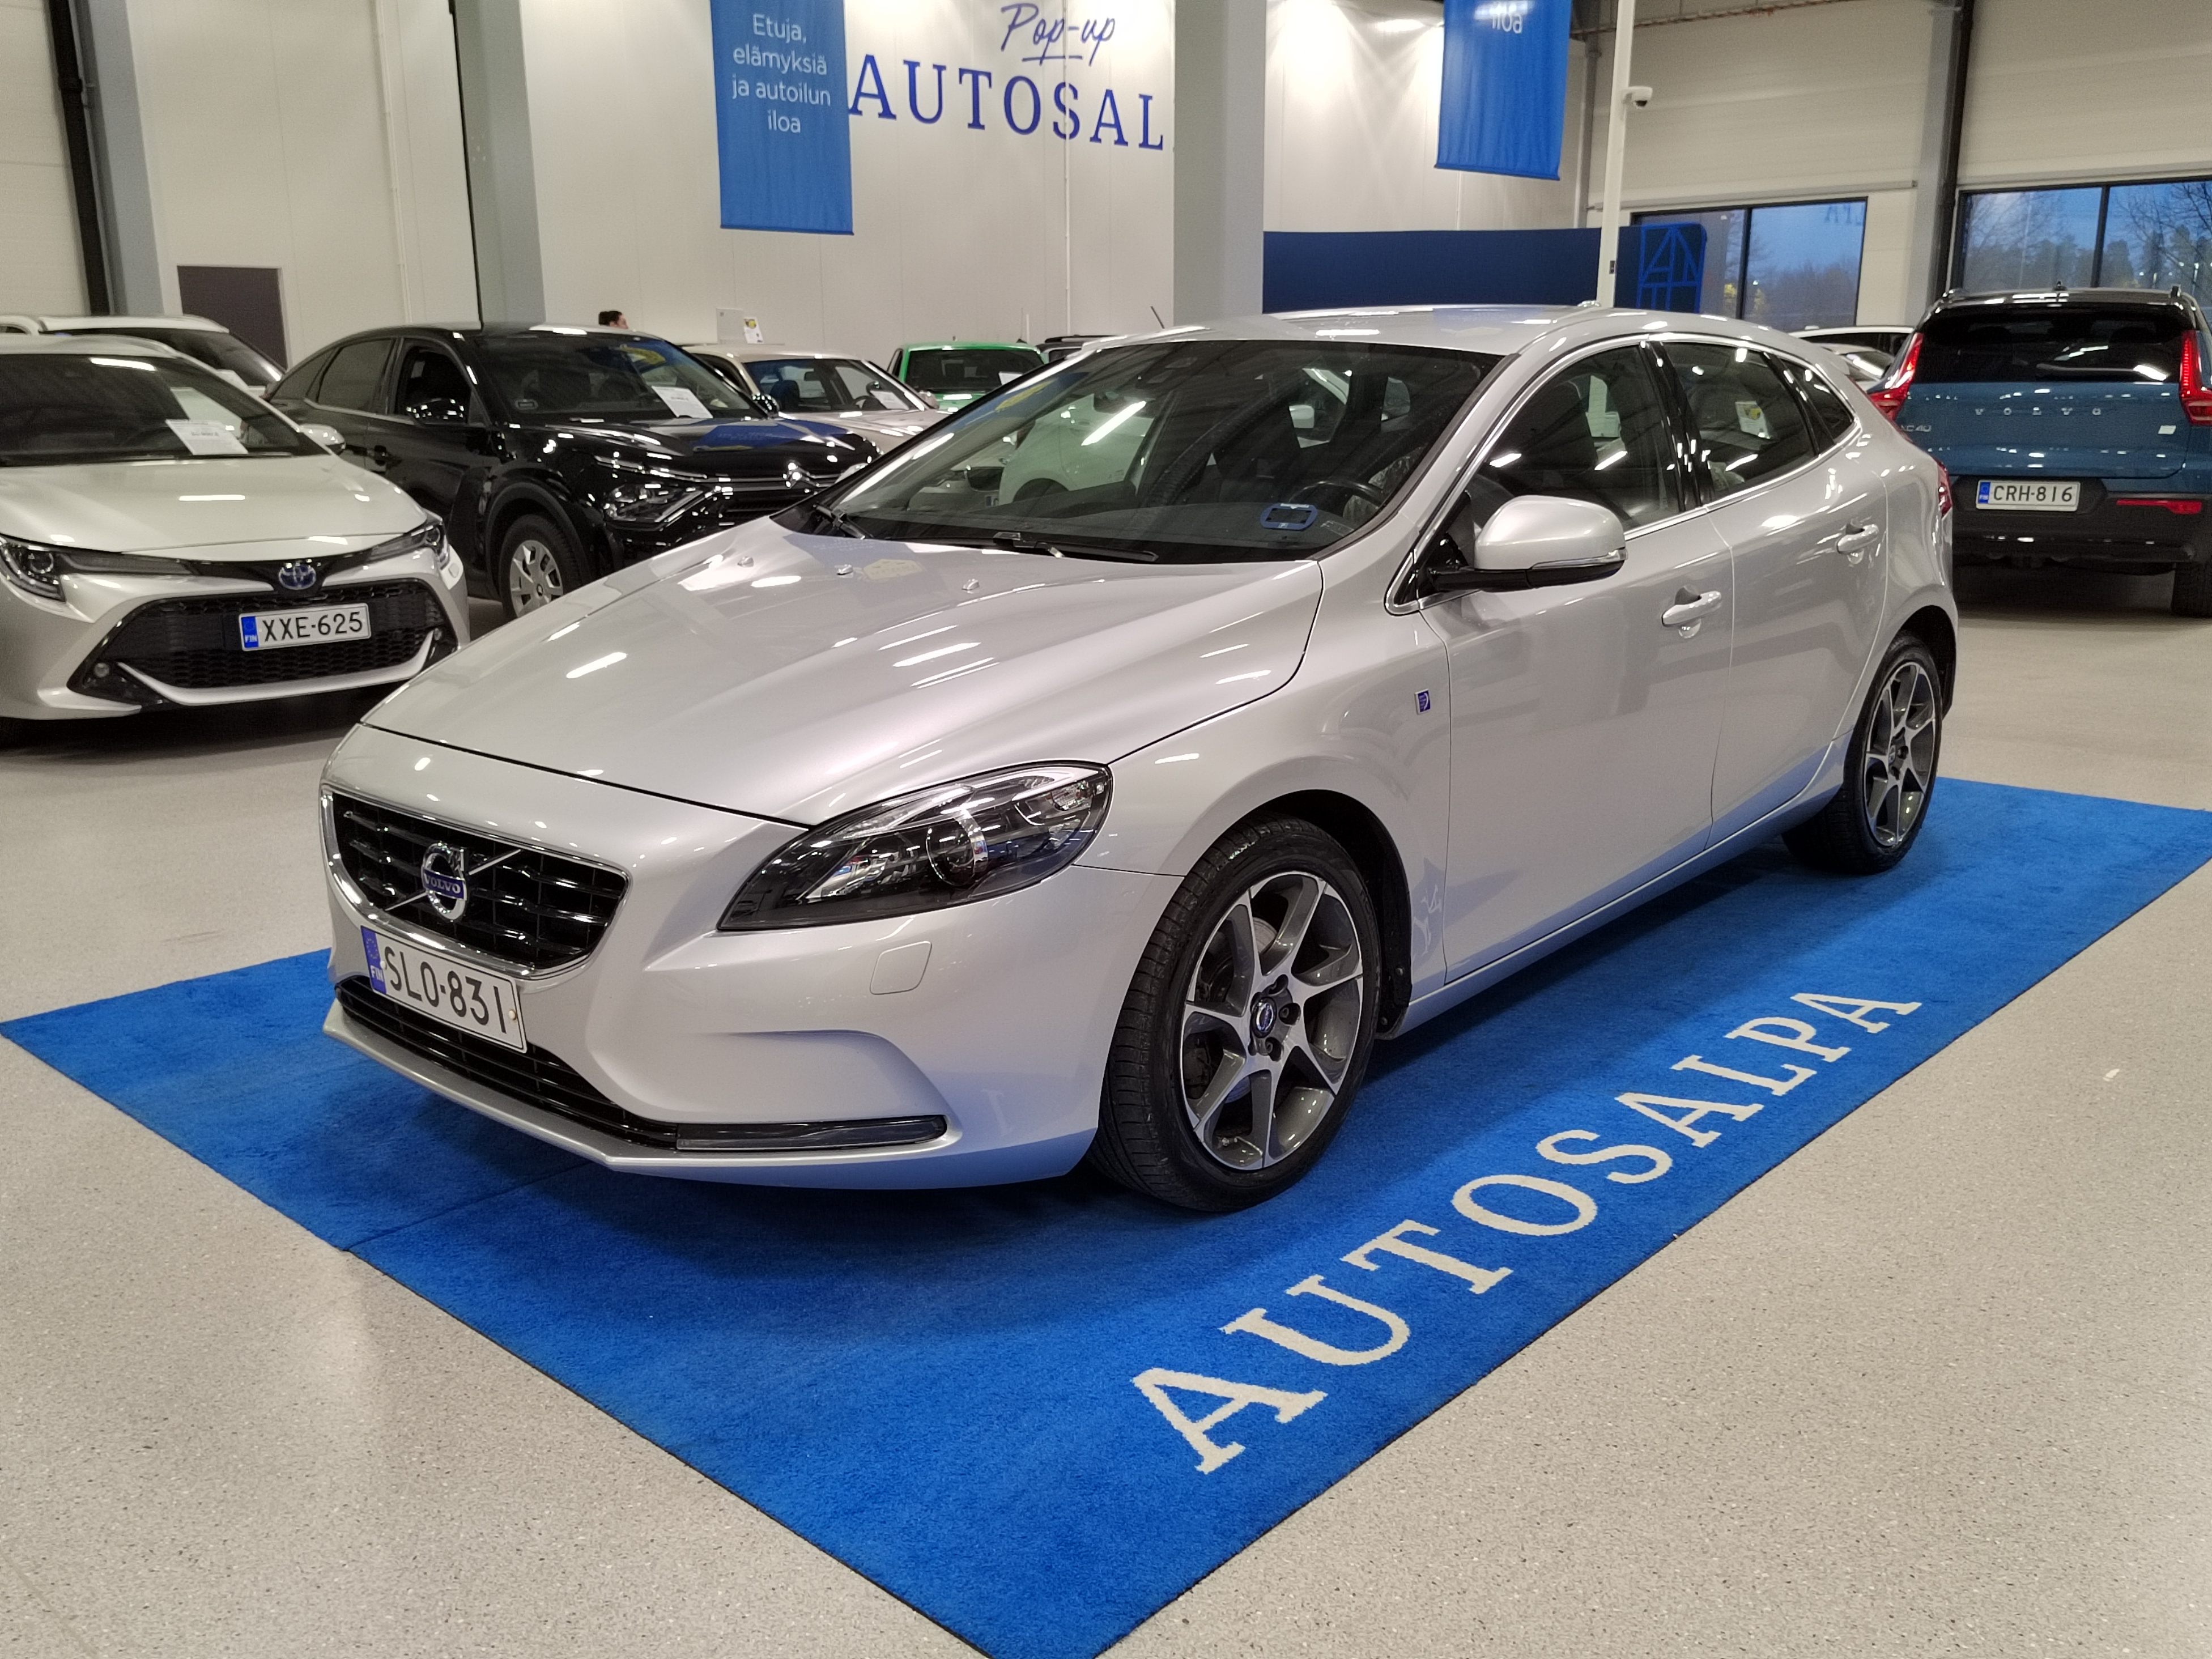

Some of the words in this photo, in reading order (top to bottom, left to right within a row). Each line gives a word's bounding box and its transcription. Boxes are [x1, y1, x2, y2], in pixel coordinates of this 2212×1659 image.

[753, 14, 806, 44] Etuja,
[1001, 3, 1115, 66] Pop-up
[733, 42, 827, 75] elämyksiä
[732, 73, 749, 99] ja
[755, 80, 831, 107] autoilun
[848, 54, 1163, 151] AUTOSAL
[768, 109, 801, 133] iloa
[1993, 485, 2073, 503] CRH-816
[262, 611, 363, 642] XXE-625
[424, 873, 461, 894] VOLVO
[370, 965, 384, 982] FIN
[384, 946, 507, 1034] SLO-831
[1133, 993, 1922, 1474] AUTOSALPA
